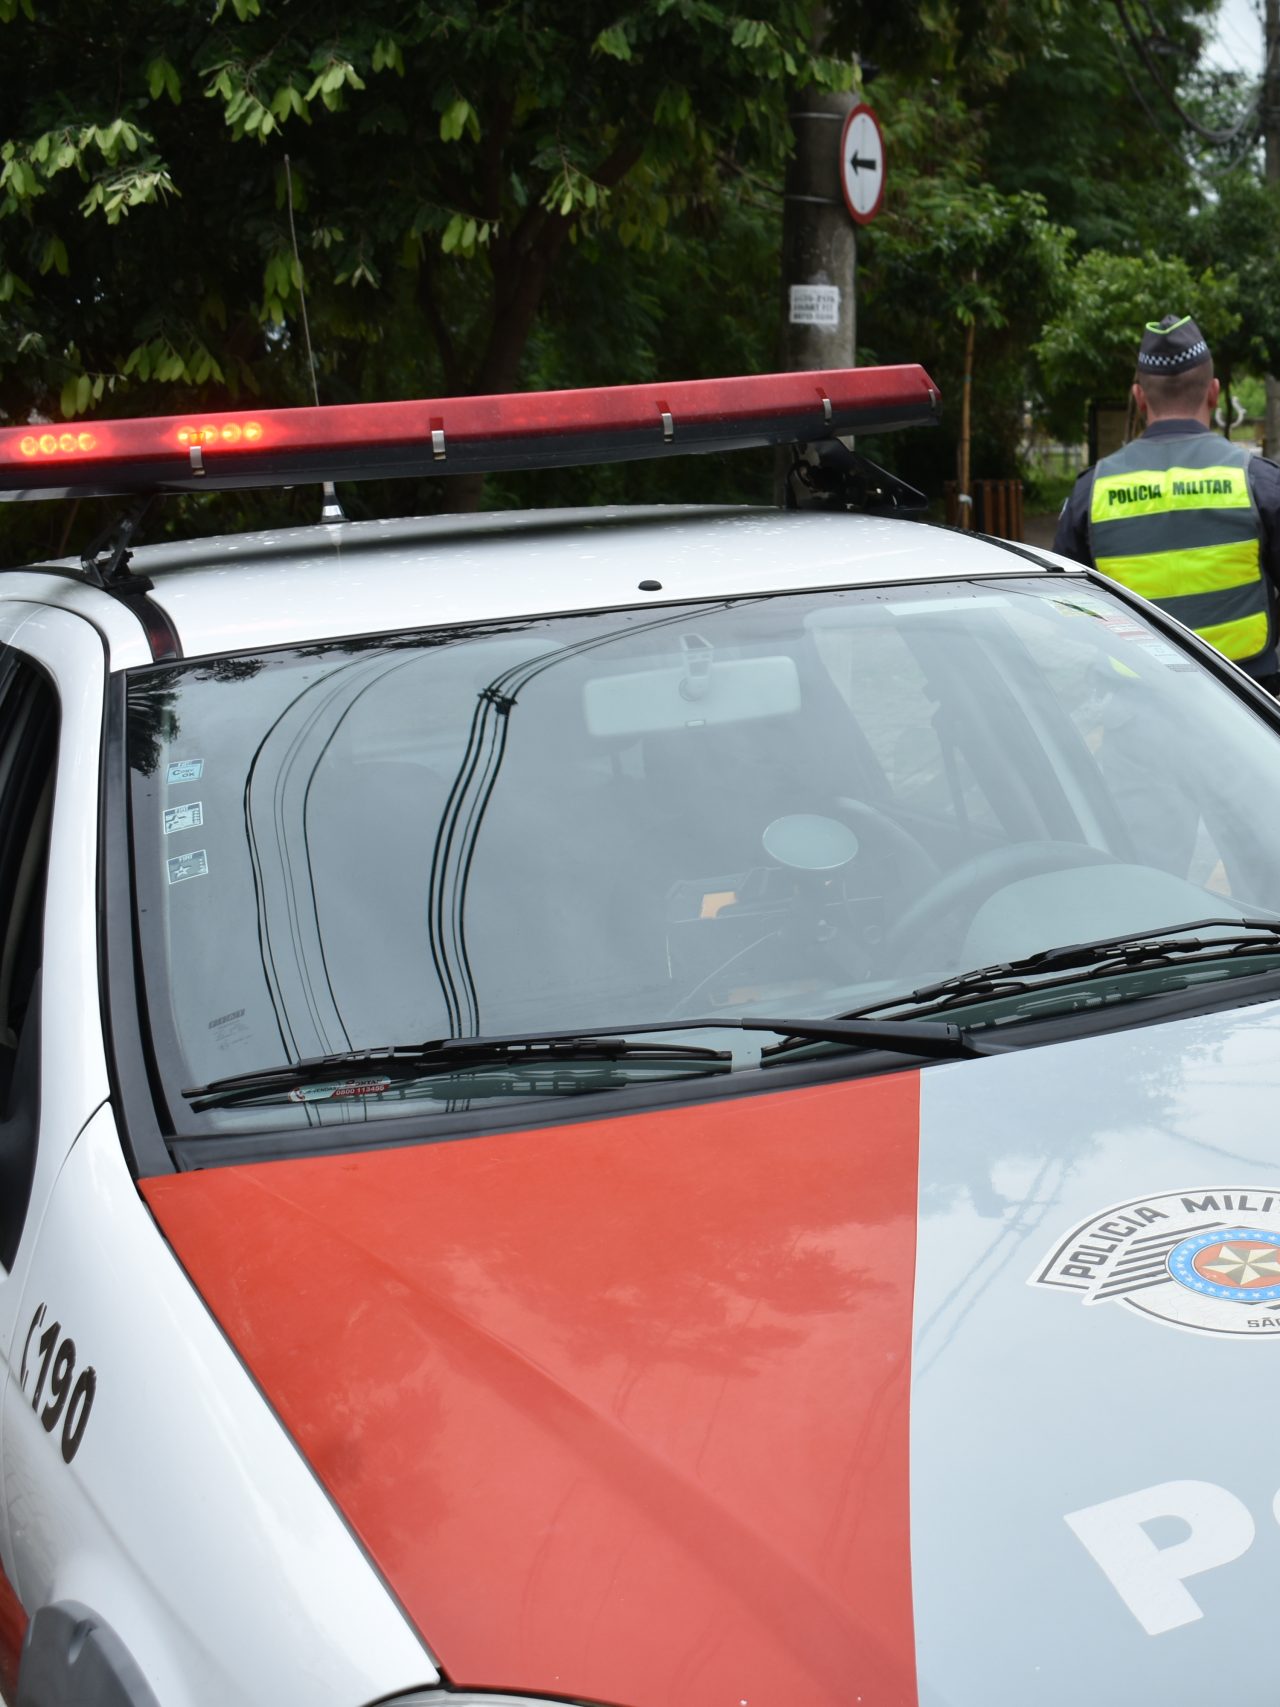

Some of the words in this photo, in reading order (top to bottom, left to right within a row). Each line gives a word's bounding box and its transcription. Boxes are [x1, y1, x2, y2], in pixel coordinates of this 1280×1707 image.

[1108, 484, 1163, 506] POLICIA
[1172, 479, 1233, 496] MILITAR
[335, 1088, 355, 1096] 0800
[1059, 1206, 1170, 1280] POLICIA
[32, 1320, 97, 1465] 190
